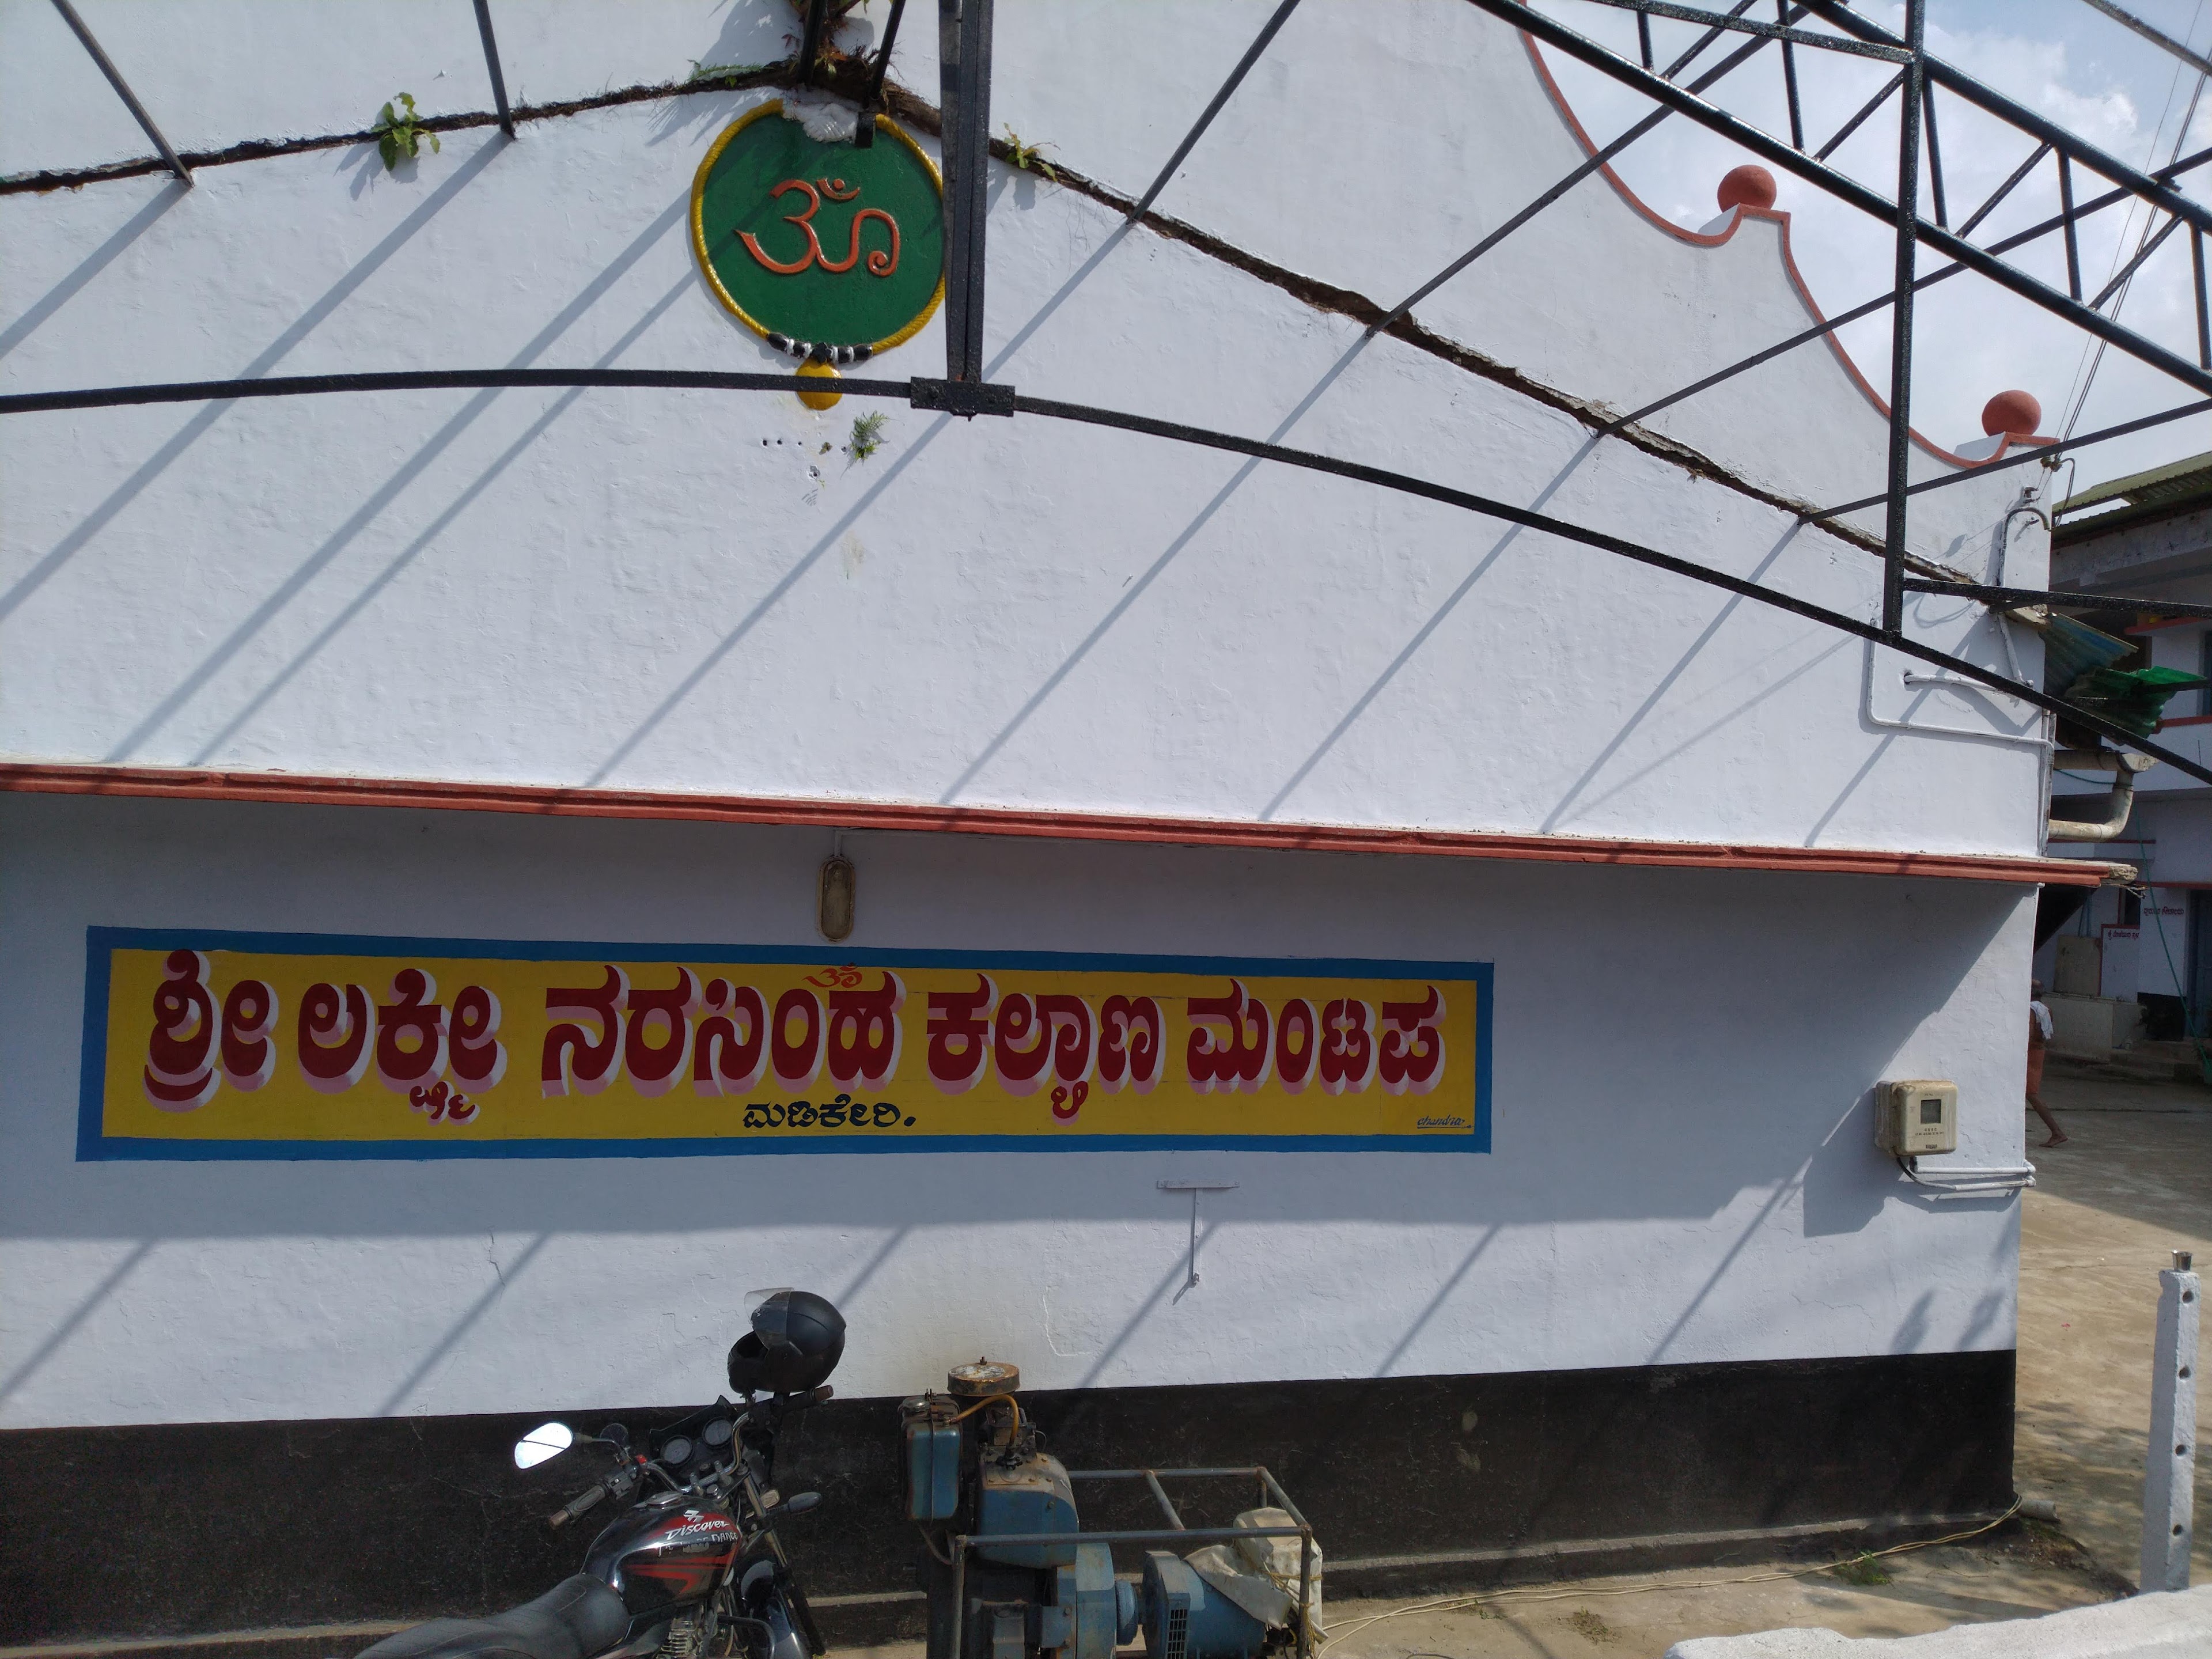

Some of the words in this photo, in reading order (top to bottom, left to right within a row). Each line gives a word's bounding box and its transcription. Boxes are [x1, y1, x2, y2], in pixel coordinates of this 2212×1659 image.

[143, 949, 278, 1112] ಶ್ರೀ
[298, 968, 506, 1126] ಲಕ್ಷ್ಮೀ
[541, 965, 906, 1098] ನರಸಿಂಹ
[927, 973, 1165, 1126] ಕಲ್ಯಾಣ
[1187, 979, 1446, 1095] ಮಂಟಪ
[664, 1520, 730, 1540] Discover
